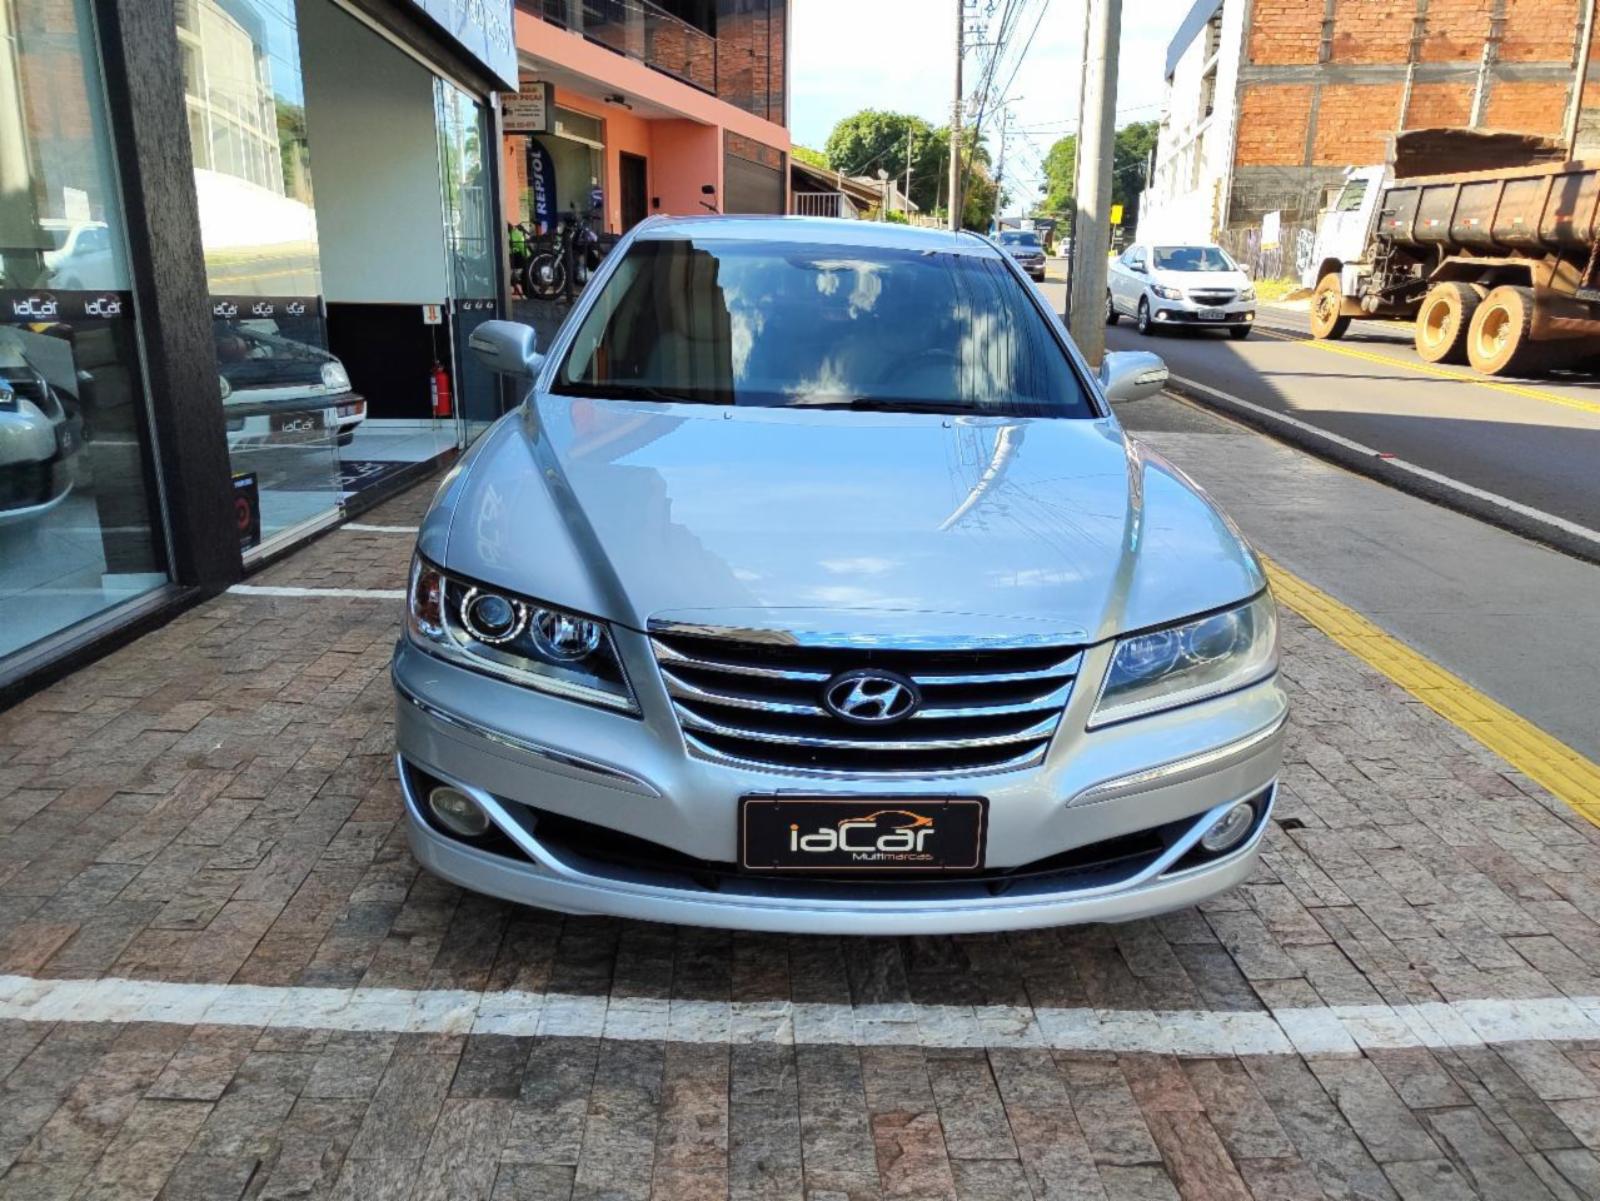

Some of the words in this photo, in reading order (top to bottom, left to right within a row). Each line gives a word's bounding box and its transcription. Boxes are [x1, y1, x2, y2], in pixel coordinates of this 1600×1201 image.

[531, 150, 547, 215] REPSOL
[790, 821, 934, 852] iaCar
[852, 852, 934, 861] Multimarcas
